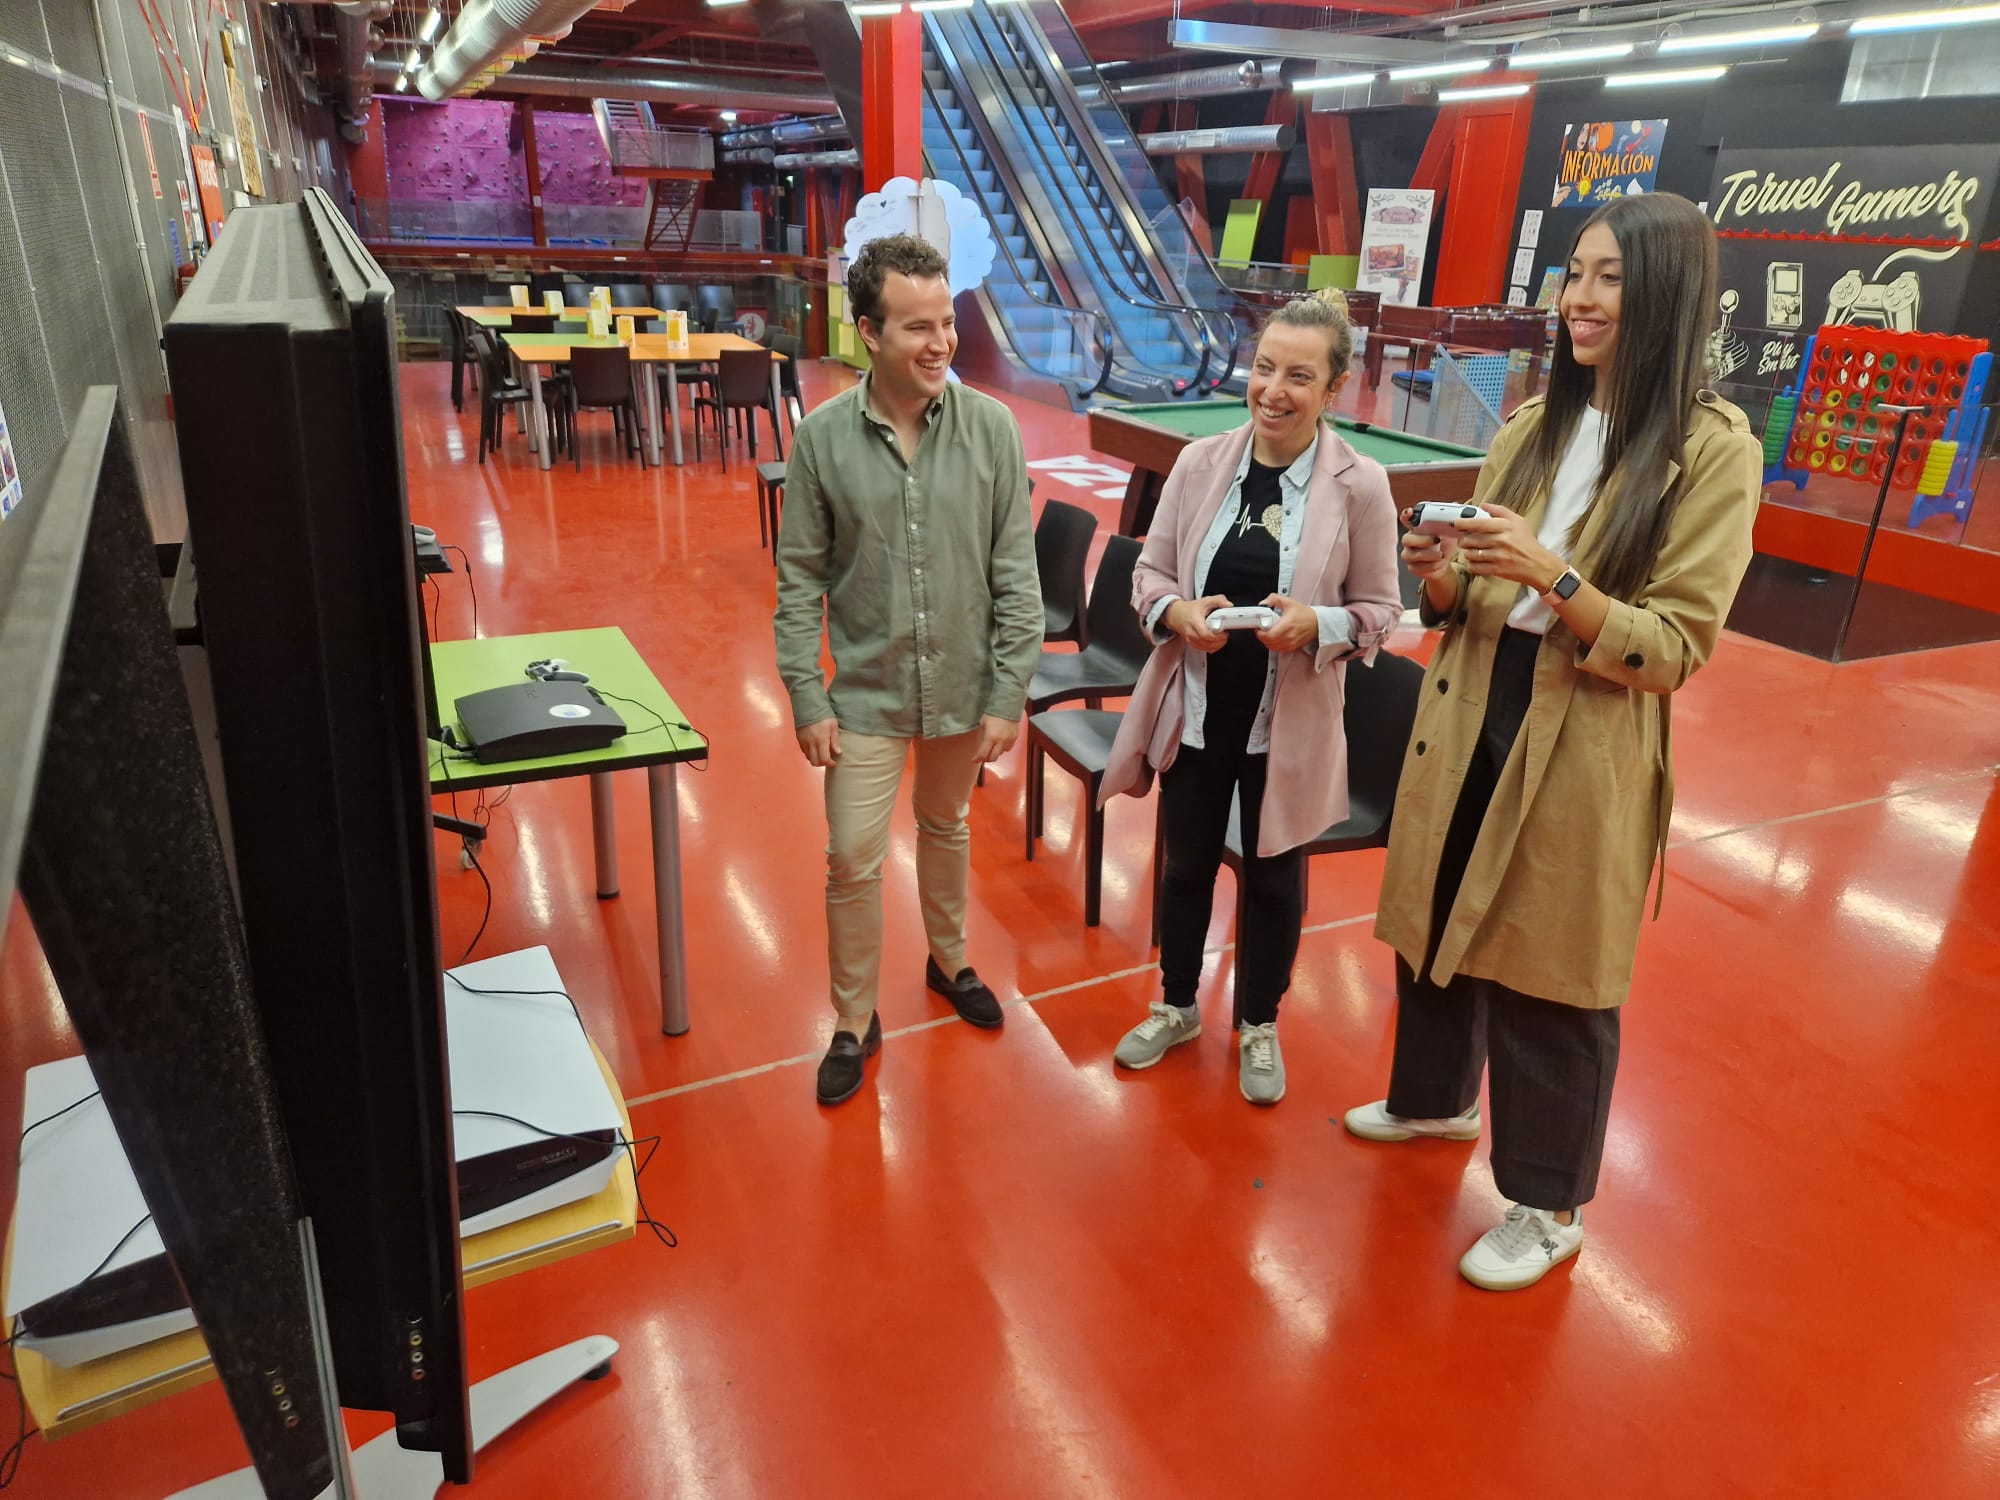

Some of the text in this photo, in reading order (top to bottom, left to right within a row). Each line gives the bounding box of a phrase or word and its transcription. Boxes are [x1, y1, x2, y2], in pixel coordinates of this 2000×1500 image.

[1561, 150, 1655, 184] INFORMACIÓN
[1713, 161, 1979, 236] Teruel Gamers
